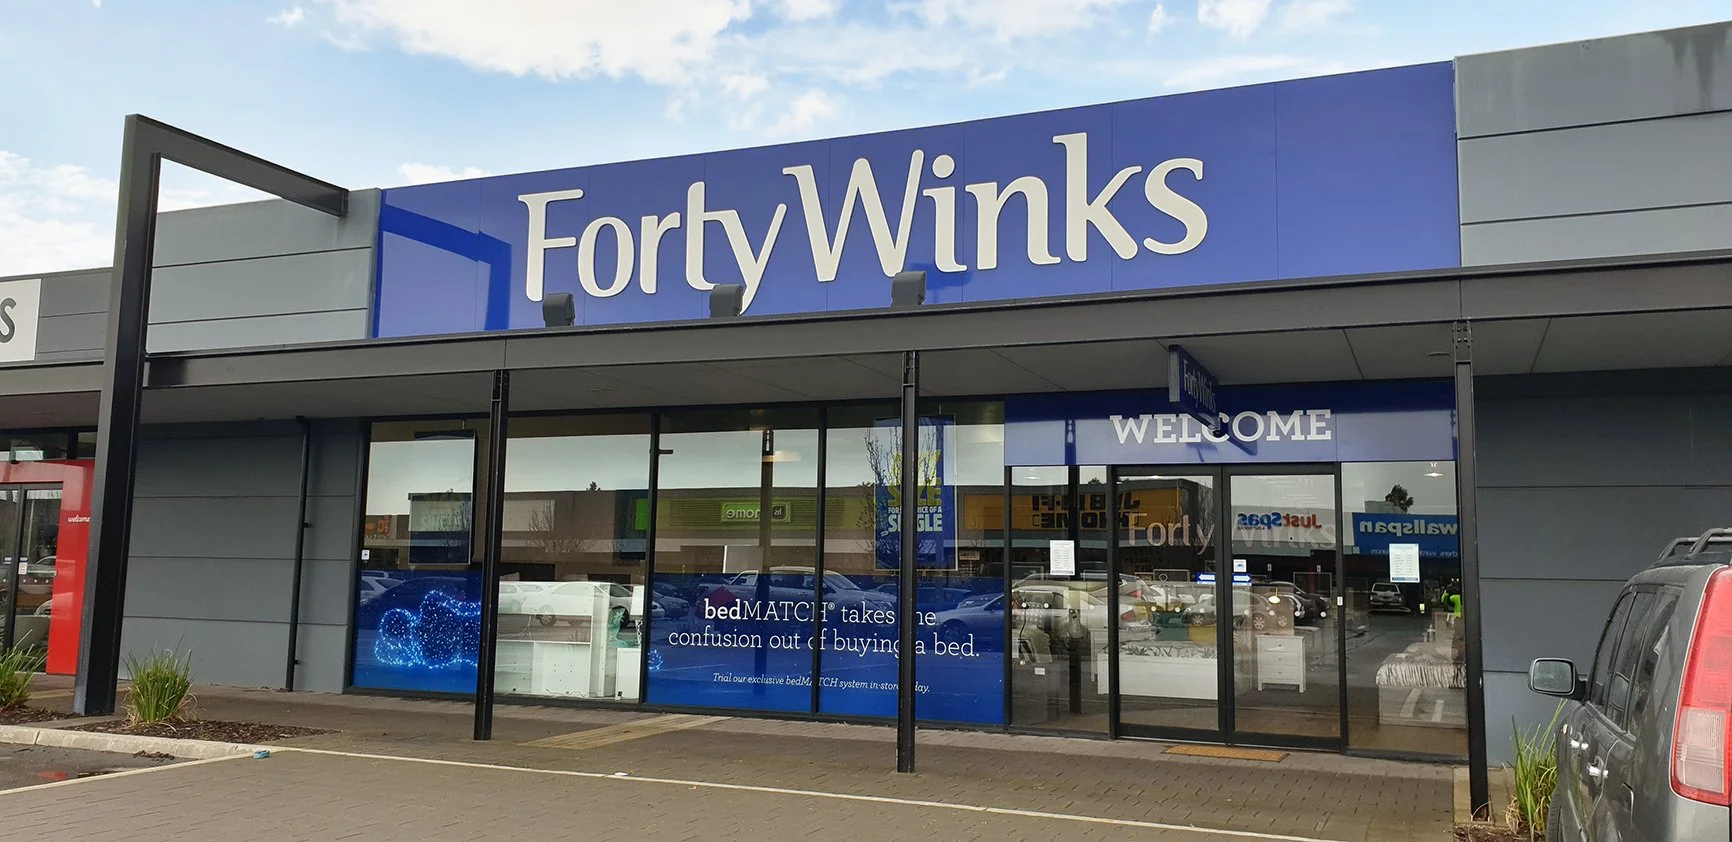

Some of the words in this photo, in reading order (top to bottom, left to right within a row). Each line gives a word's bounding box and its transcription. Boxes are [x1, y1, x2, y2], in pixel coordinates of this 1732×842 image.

[1109, 409, 1332, 444] WELCOME
[888, 478, 942, 506] SZE
[888, 514, 942, 532] SIGLE
[1127, 512, 1216, 556] Forty
[840, 601, 896, 625] takes
[668, 628, 763, 649] confusion
[769, 632, 801, 651] out
[914, 639, 926, 656] a
[933, 632, 981, 658] bed.
[713, 672, 732, 684] Trial
[732, 676, 747, 684] our
[747, 674, 784, 686] exclusive
[838, 679, 869, 692] system
